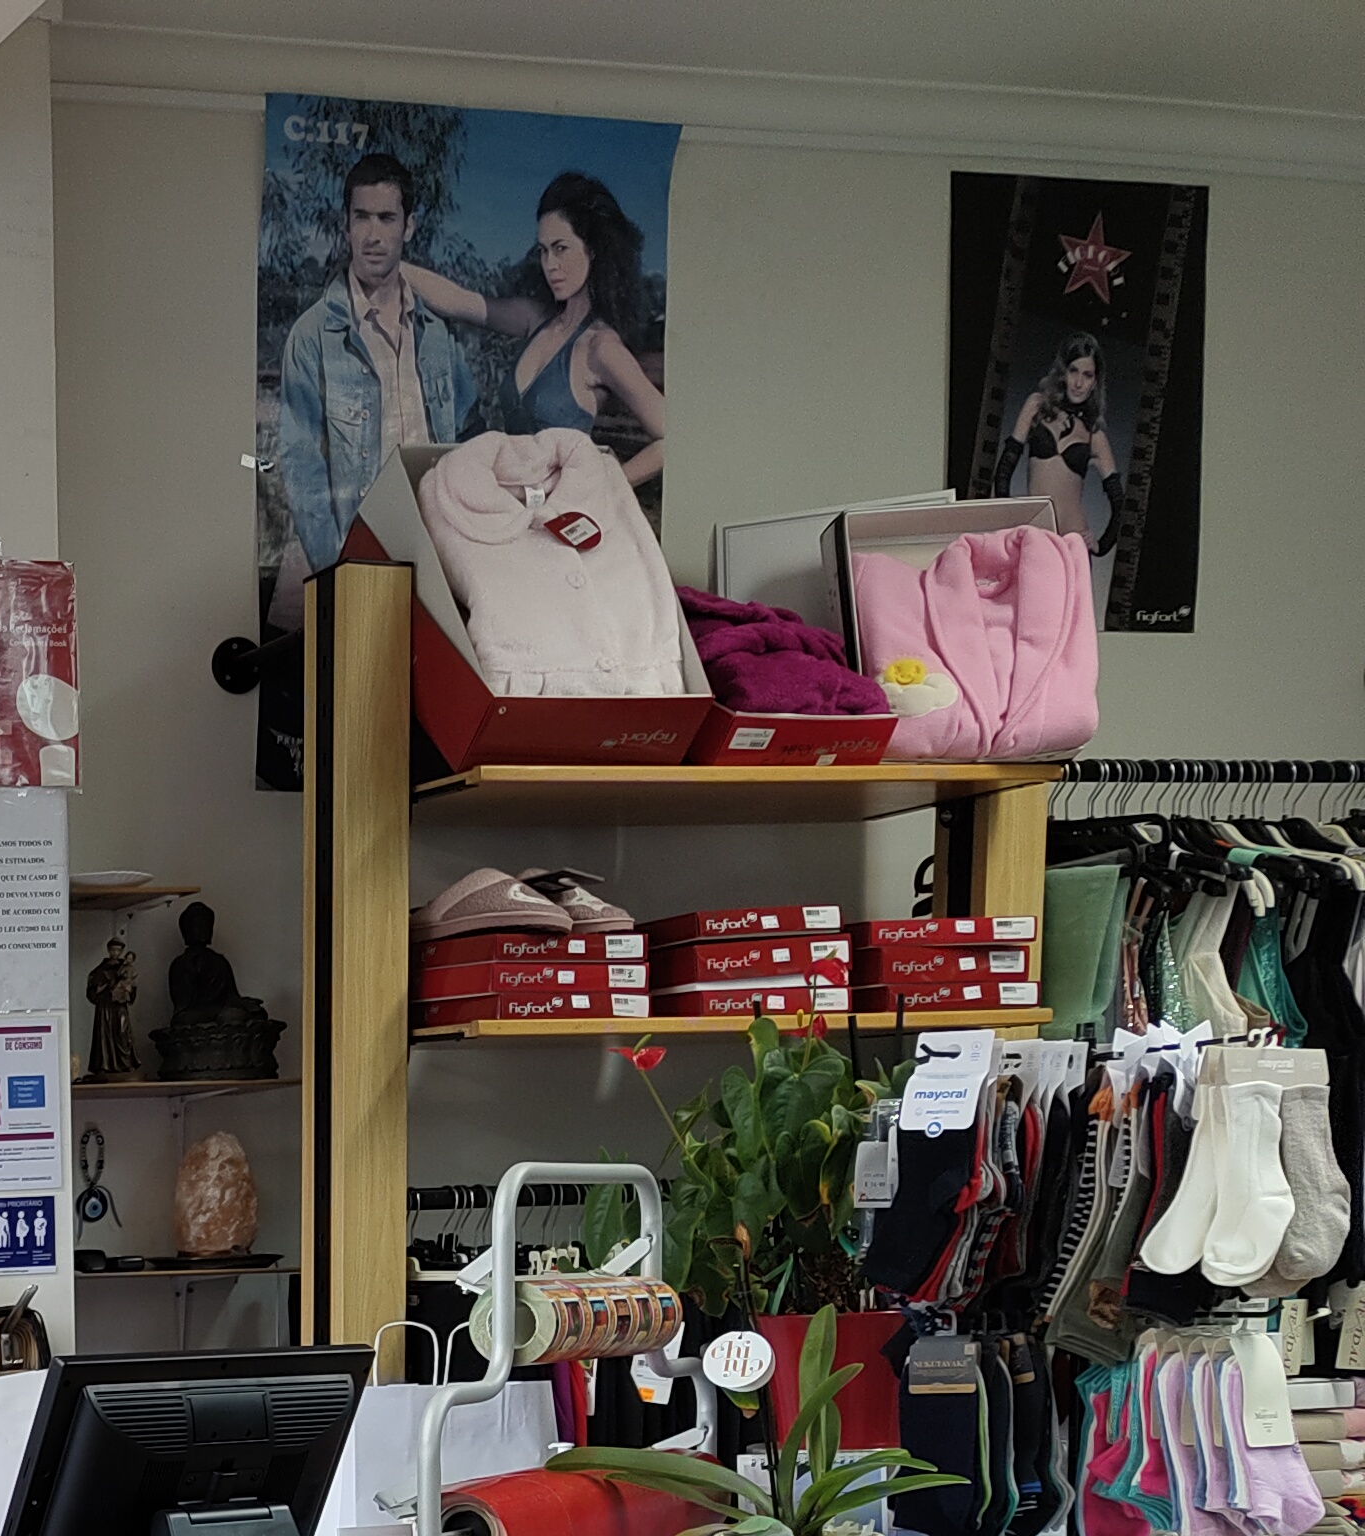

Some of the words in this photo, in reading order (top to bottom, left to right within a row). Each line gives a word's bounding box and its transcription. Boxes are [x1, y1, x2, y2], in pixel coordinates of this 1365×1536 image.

[283, 114, 370, 151] C.117
[1136, 609, 1179, 625] figfort
[706, 917, 751, 934] figfort
[878, 924, 927, 941] figfort
[503, 941, 547, 957] figfort
[706, 957, 752, 972] figfort
[892, 960, 937, 975] figfort
[499, 971, 544, 986] figfort
[508, 1001, 553, 1015] figfort
[709, 997, 754, 1012] figfort
[914, 1088, 968, 1101] mayoral
